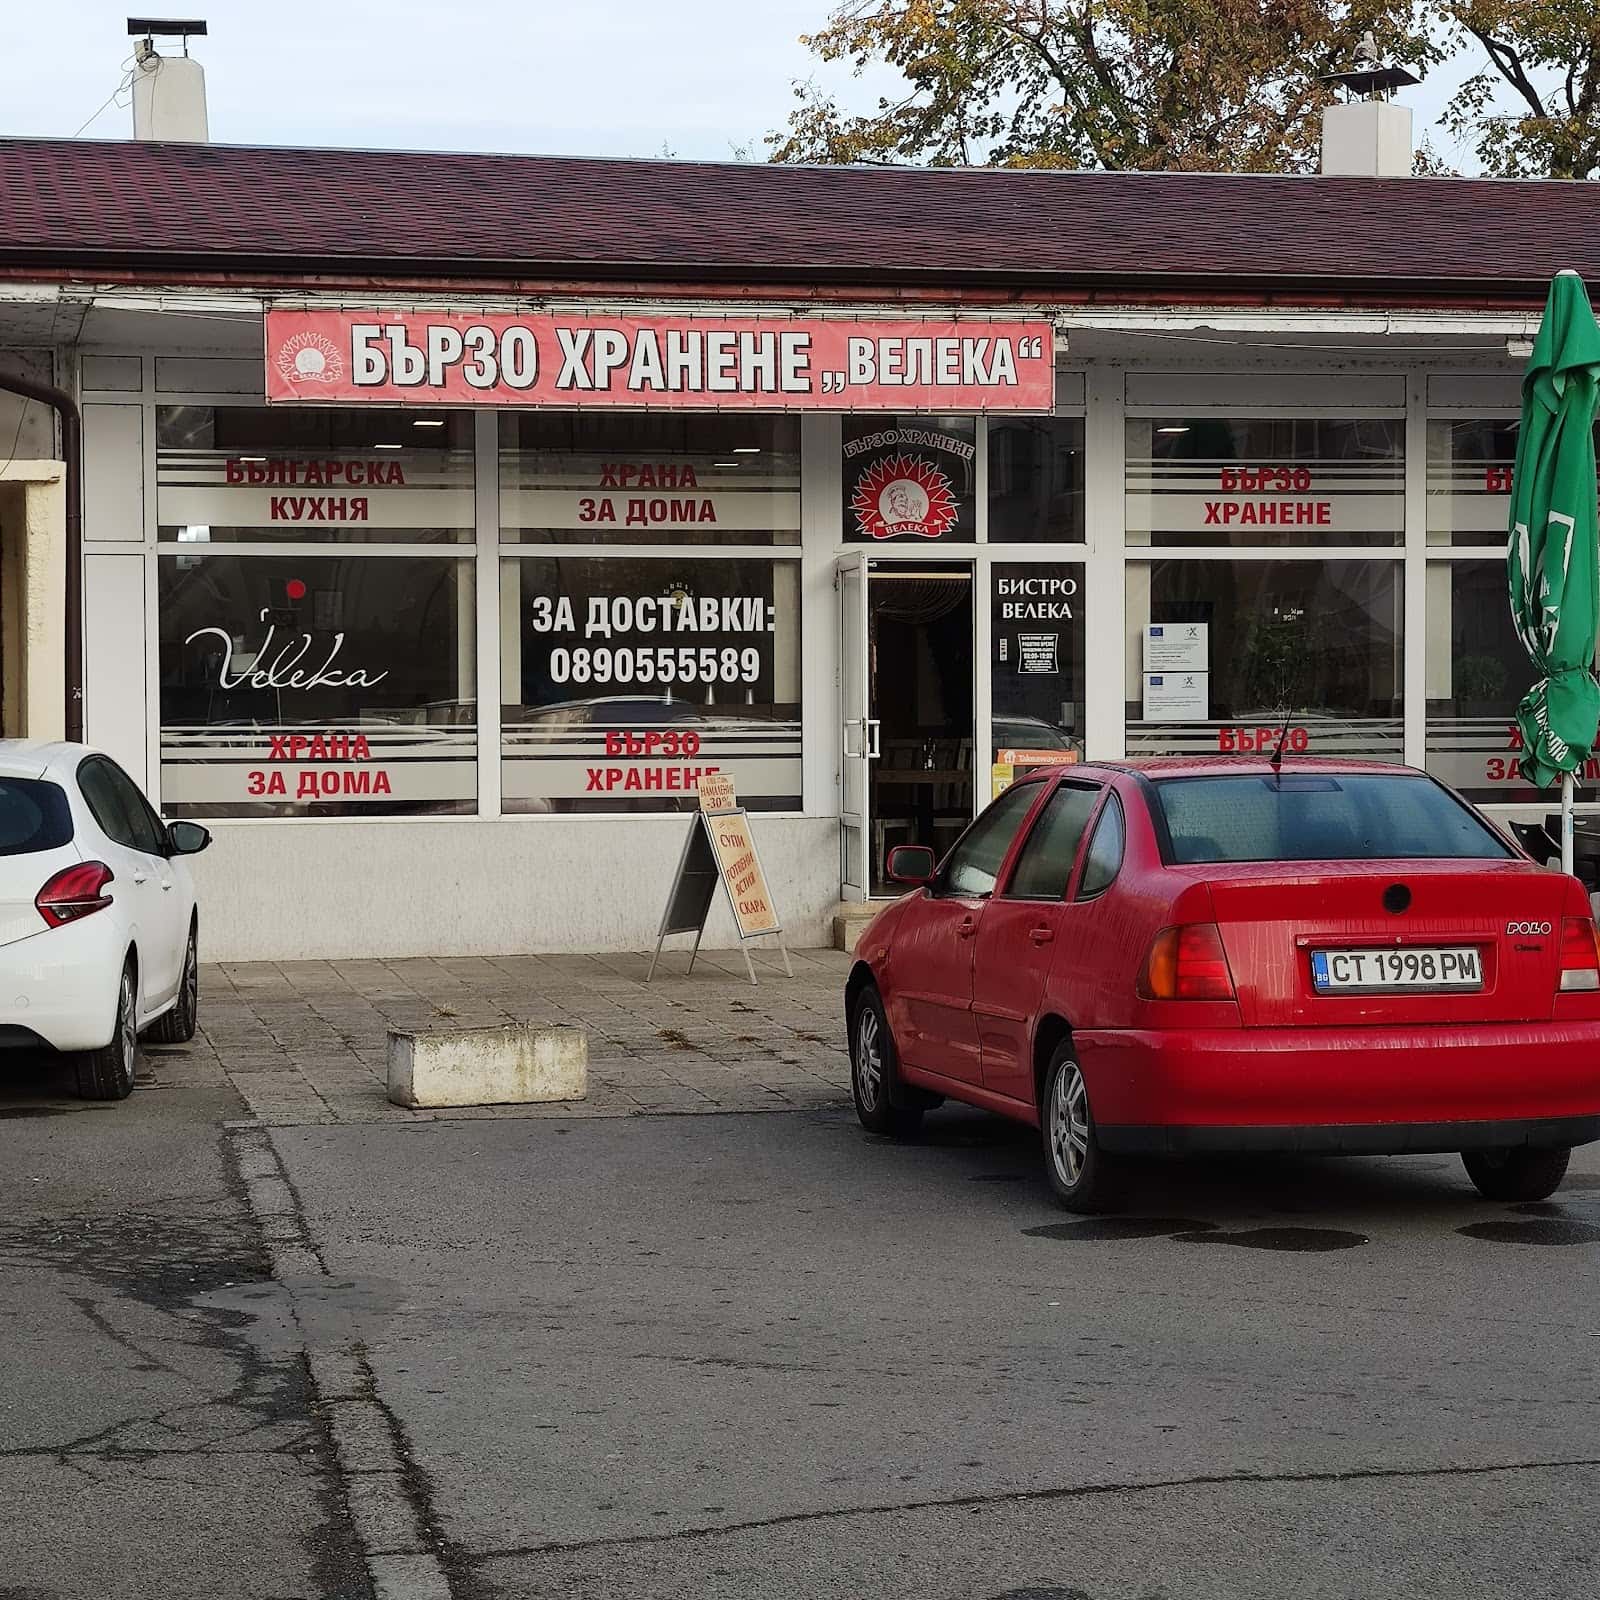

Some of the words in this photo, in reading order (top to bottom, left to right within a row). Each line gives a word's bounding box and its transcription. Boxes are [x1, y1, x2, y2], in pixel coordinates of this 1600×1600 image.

[351, 324, 539, 390] БЪРЗО
[555, 328, 812, 393] ХРАНЕНЕ
[843, 429, 899, 458] БЪРЗО
[899, 428, 975, 460] ХРАНЕНЕ
[225, 459, 405, 485] БЪЛГАРСКА
[600, 464, 698, 488] ХРАНА
[1220, 467, 1311, 492] БЪРЗО
[270, 496, 368, 521] КУХНЯ
[579, 498, 616, 522] ЗА
[626, 499, 717, 526] ДОМА
[1204, 502, 1331, 525] ХРАНЕНЕ
[885, 523, 929, 535] ВЕЛЕКА
[998, 578, 1077, 595] БИСТРО
[532, 597, 576, 632] ЗА
[585, 597, 776, 639] ДОСТАВКИ:
[1002, 602, 1073, 619] ВЕЛЕКА
[184, 608, 389, 691] Veleka
[550, 648, 760, 683] 0890555589
[268, 735, 372, 760] ХРАНА
[605, 731, 700, 756] БЪРЗО
[1218, 728, 1309, 752] БЪРЗО
[247, 771, 287, 795] ЗА
[296, 771, 392, 799] ДОМА
[720, 834, 745, 848] СУПИ
[740, 899, 766, 915] СКАРА
[1506, 921, 1552, 935] POLO
